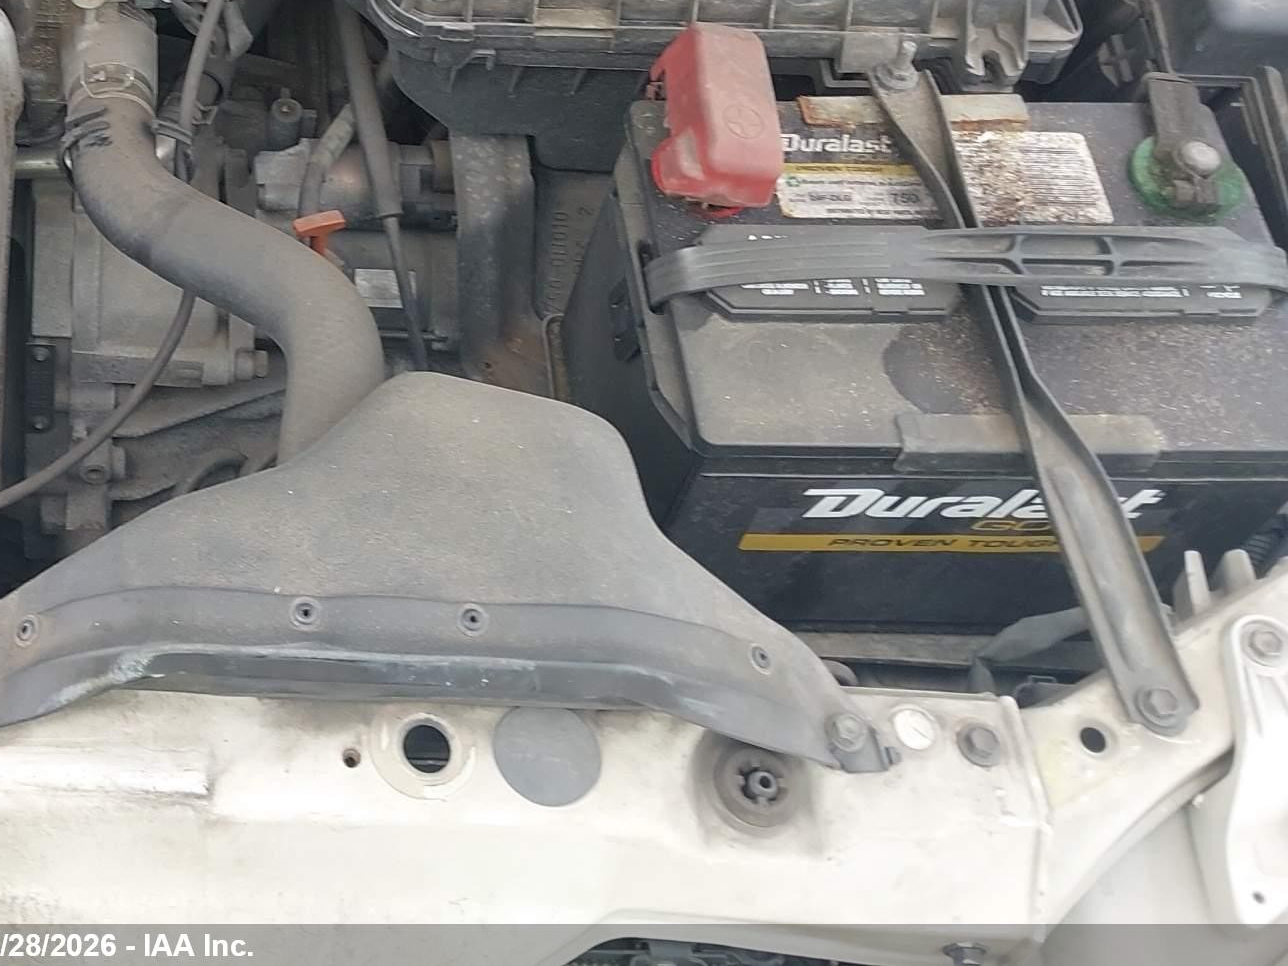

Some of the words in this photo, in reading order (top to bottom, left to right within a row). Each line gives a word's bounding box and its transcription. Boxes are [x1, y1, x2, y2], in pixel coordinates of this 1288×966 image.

[780, 134, 893, 153] Duralast
[801, 488, 1166, 519] Duralat
[828, 538, 958, 547] PROVEN
